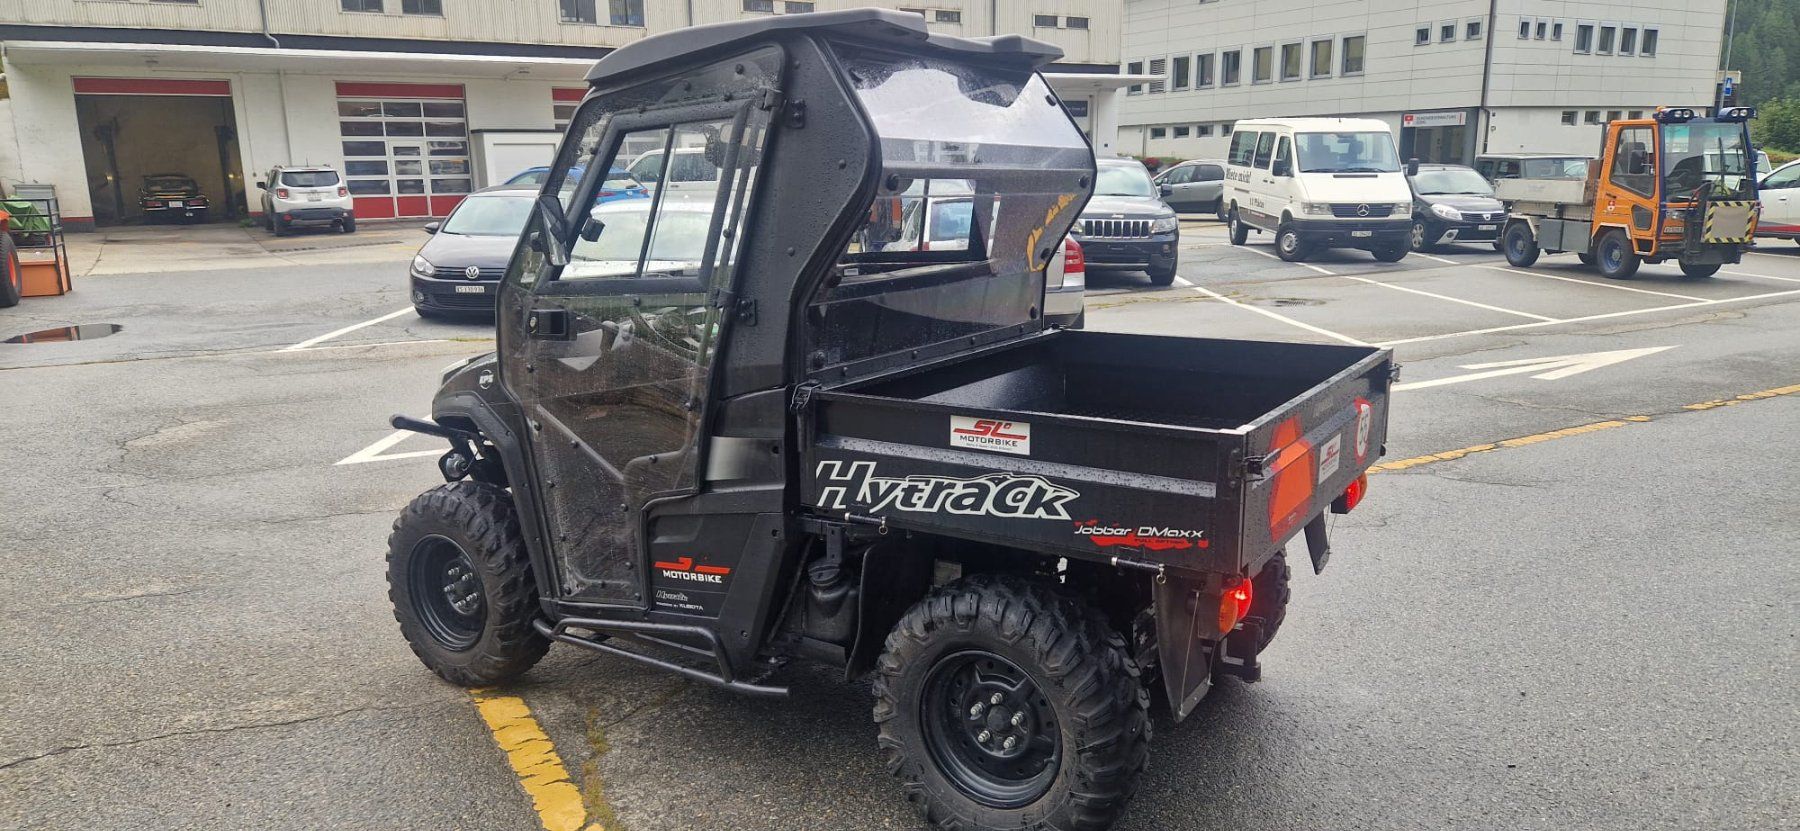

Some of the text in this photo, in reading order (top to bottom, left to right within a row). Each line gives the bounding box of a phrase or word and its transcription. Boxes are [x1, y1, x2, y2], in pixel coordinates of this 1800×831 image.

[960, 435, 1018, 447] MOTORBIKE
[816, 460, 1081, 520] Hytrack
[1074, 525, 1204, 538] Jobber DMaxx
[662, 569, 722, 583] MOTORBIKE
